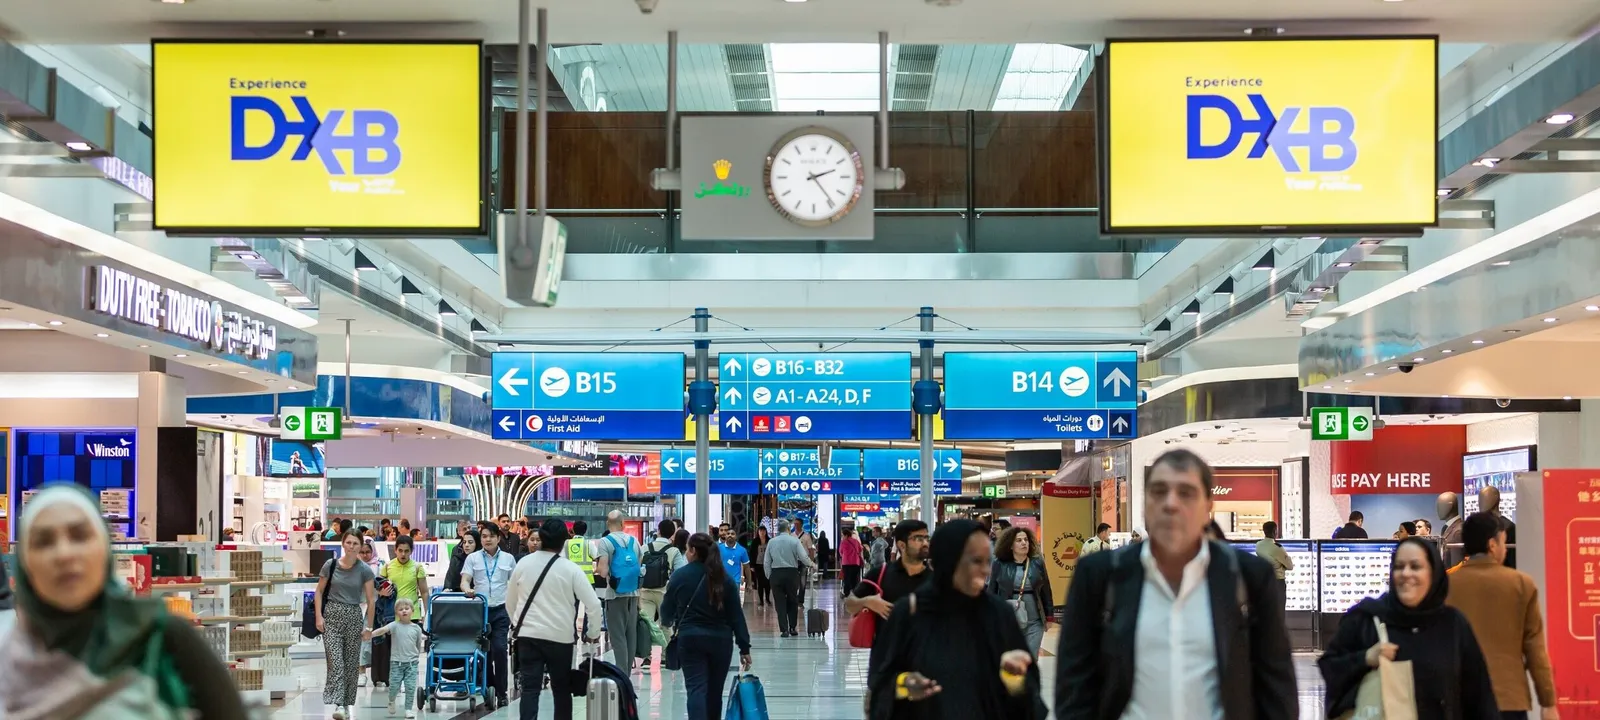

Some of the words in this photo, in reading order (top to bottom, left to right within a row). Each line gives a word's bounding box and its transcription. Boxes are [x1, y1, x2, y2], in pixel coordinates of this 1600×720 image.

[229, 78, 307, 91] Experience
[1186, 77, 1263, 89] Experience
[101, 265, 136, 319] DUTY
[134, 278, 161, 328] FREE
[166, 287, 212, 343] TOBACCO
[576, 372, 617, 393] B15
[1012, 371, 1053, 393] B14
[566, 424, 580, 432] Aid
[1056, 424, 1083, 432] Toilets
[93, 443, 130, 457] Winston
[897, 459, 919, 471] B16
[1351, 473, 1381, 488] PAY
[1387, 473, 1430, 488] HERE
[1052, 552, 1065, 568] DUBAI
